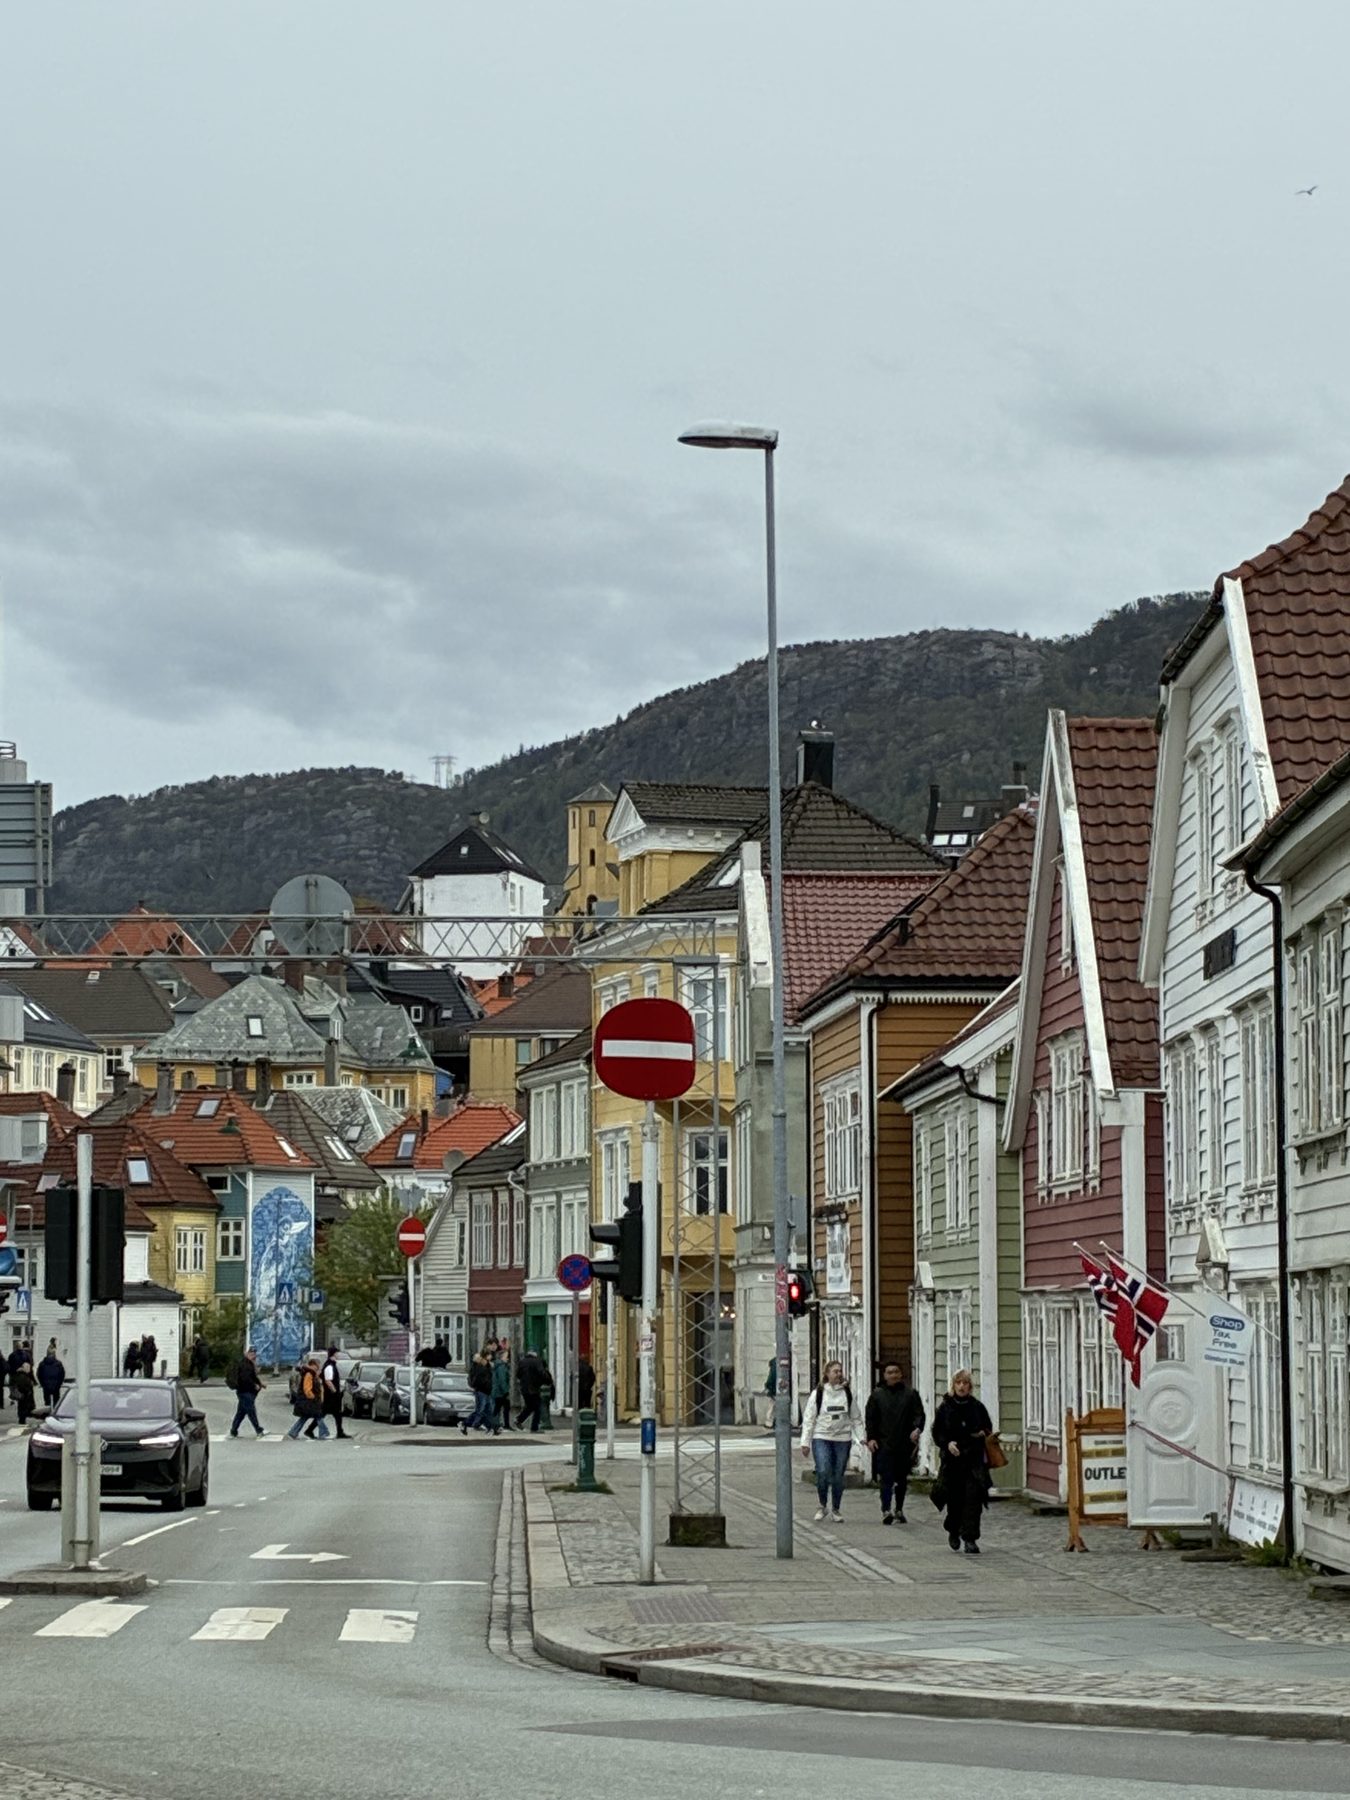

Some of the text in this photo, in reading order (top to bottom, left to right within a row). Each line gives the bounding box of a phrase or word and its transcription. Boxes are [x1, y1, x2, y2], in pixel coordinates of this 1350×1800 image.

[1212, 1316, 1243, 1330] Shop
[1213, 1328, 1231, 1339] Tax
[1212, 1338, 1237, 1349] Free
[1084, 1466, 1128, 1481] OUTLE
